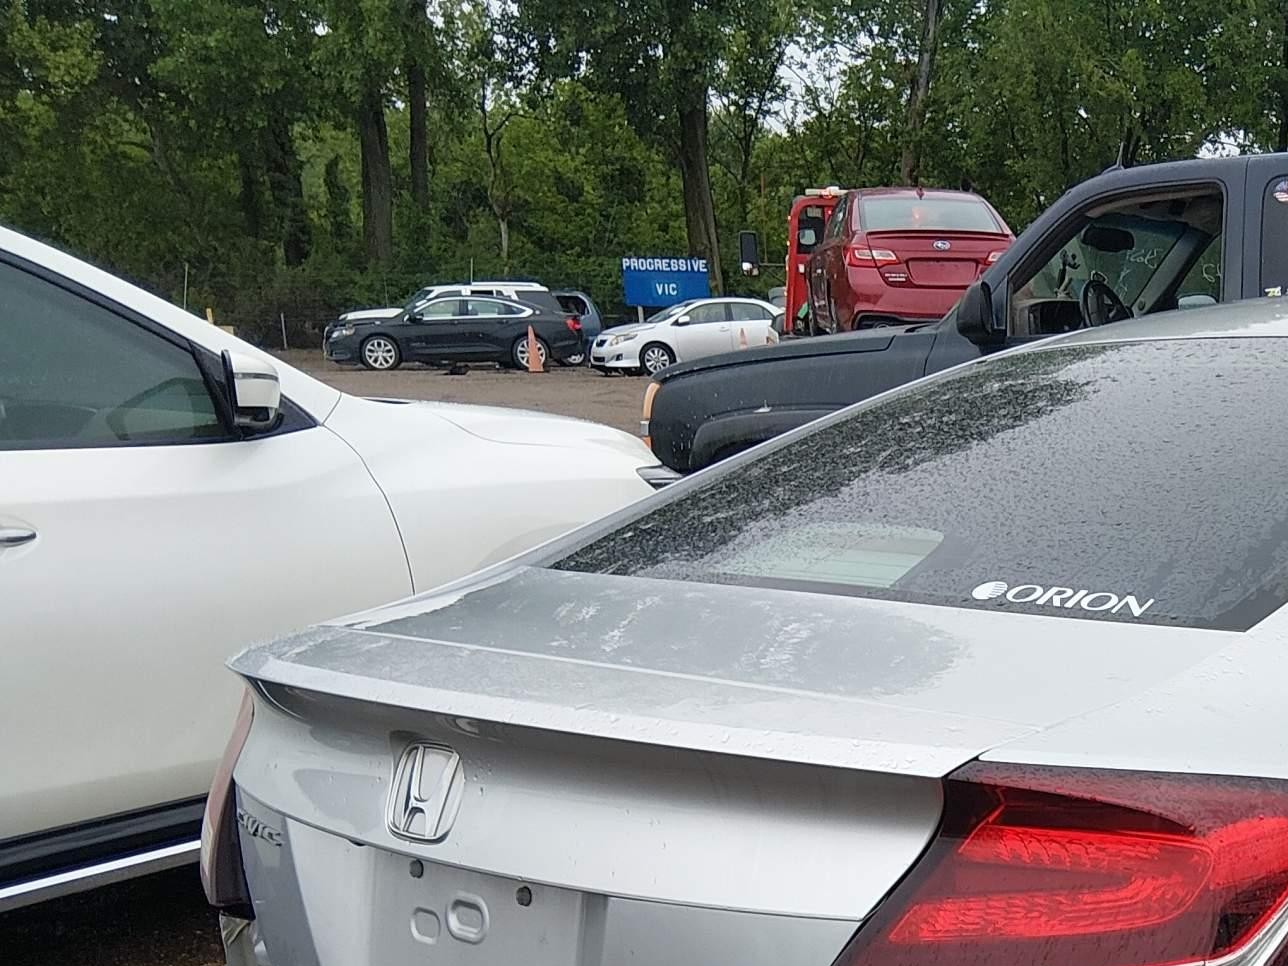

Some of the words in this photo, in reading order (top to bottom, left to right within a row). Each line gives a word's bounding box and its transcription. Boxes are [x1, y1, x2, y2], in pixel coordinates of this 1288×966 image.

[622, 258, 708, 272] PROGRESSIVE
[656, 283, 678, 296] VIC
[1006, 584, 1155, 617] ORION
[237, 809, 284, 847] CIVIC
